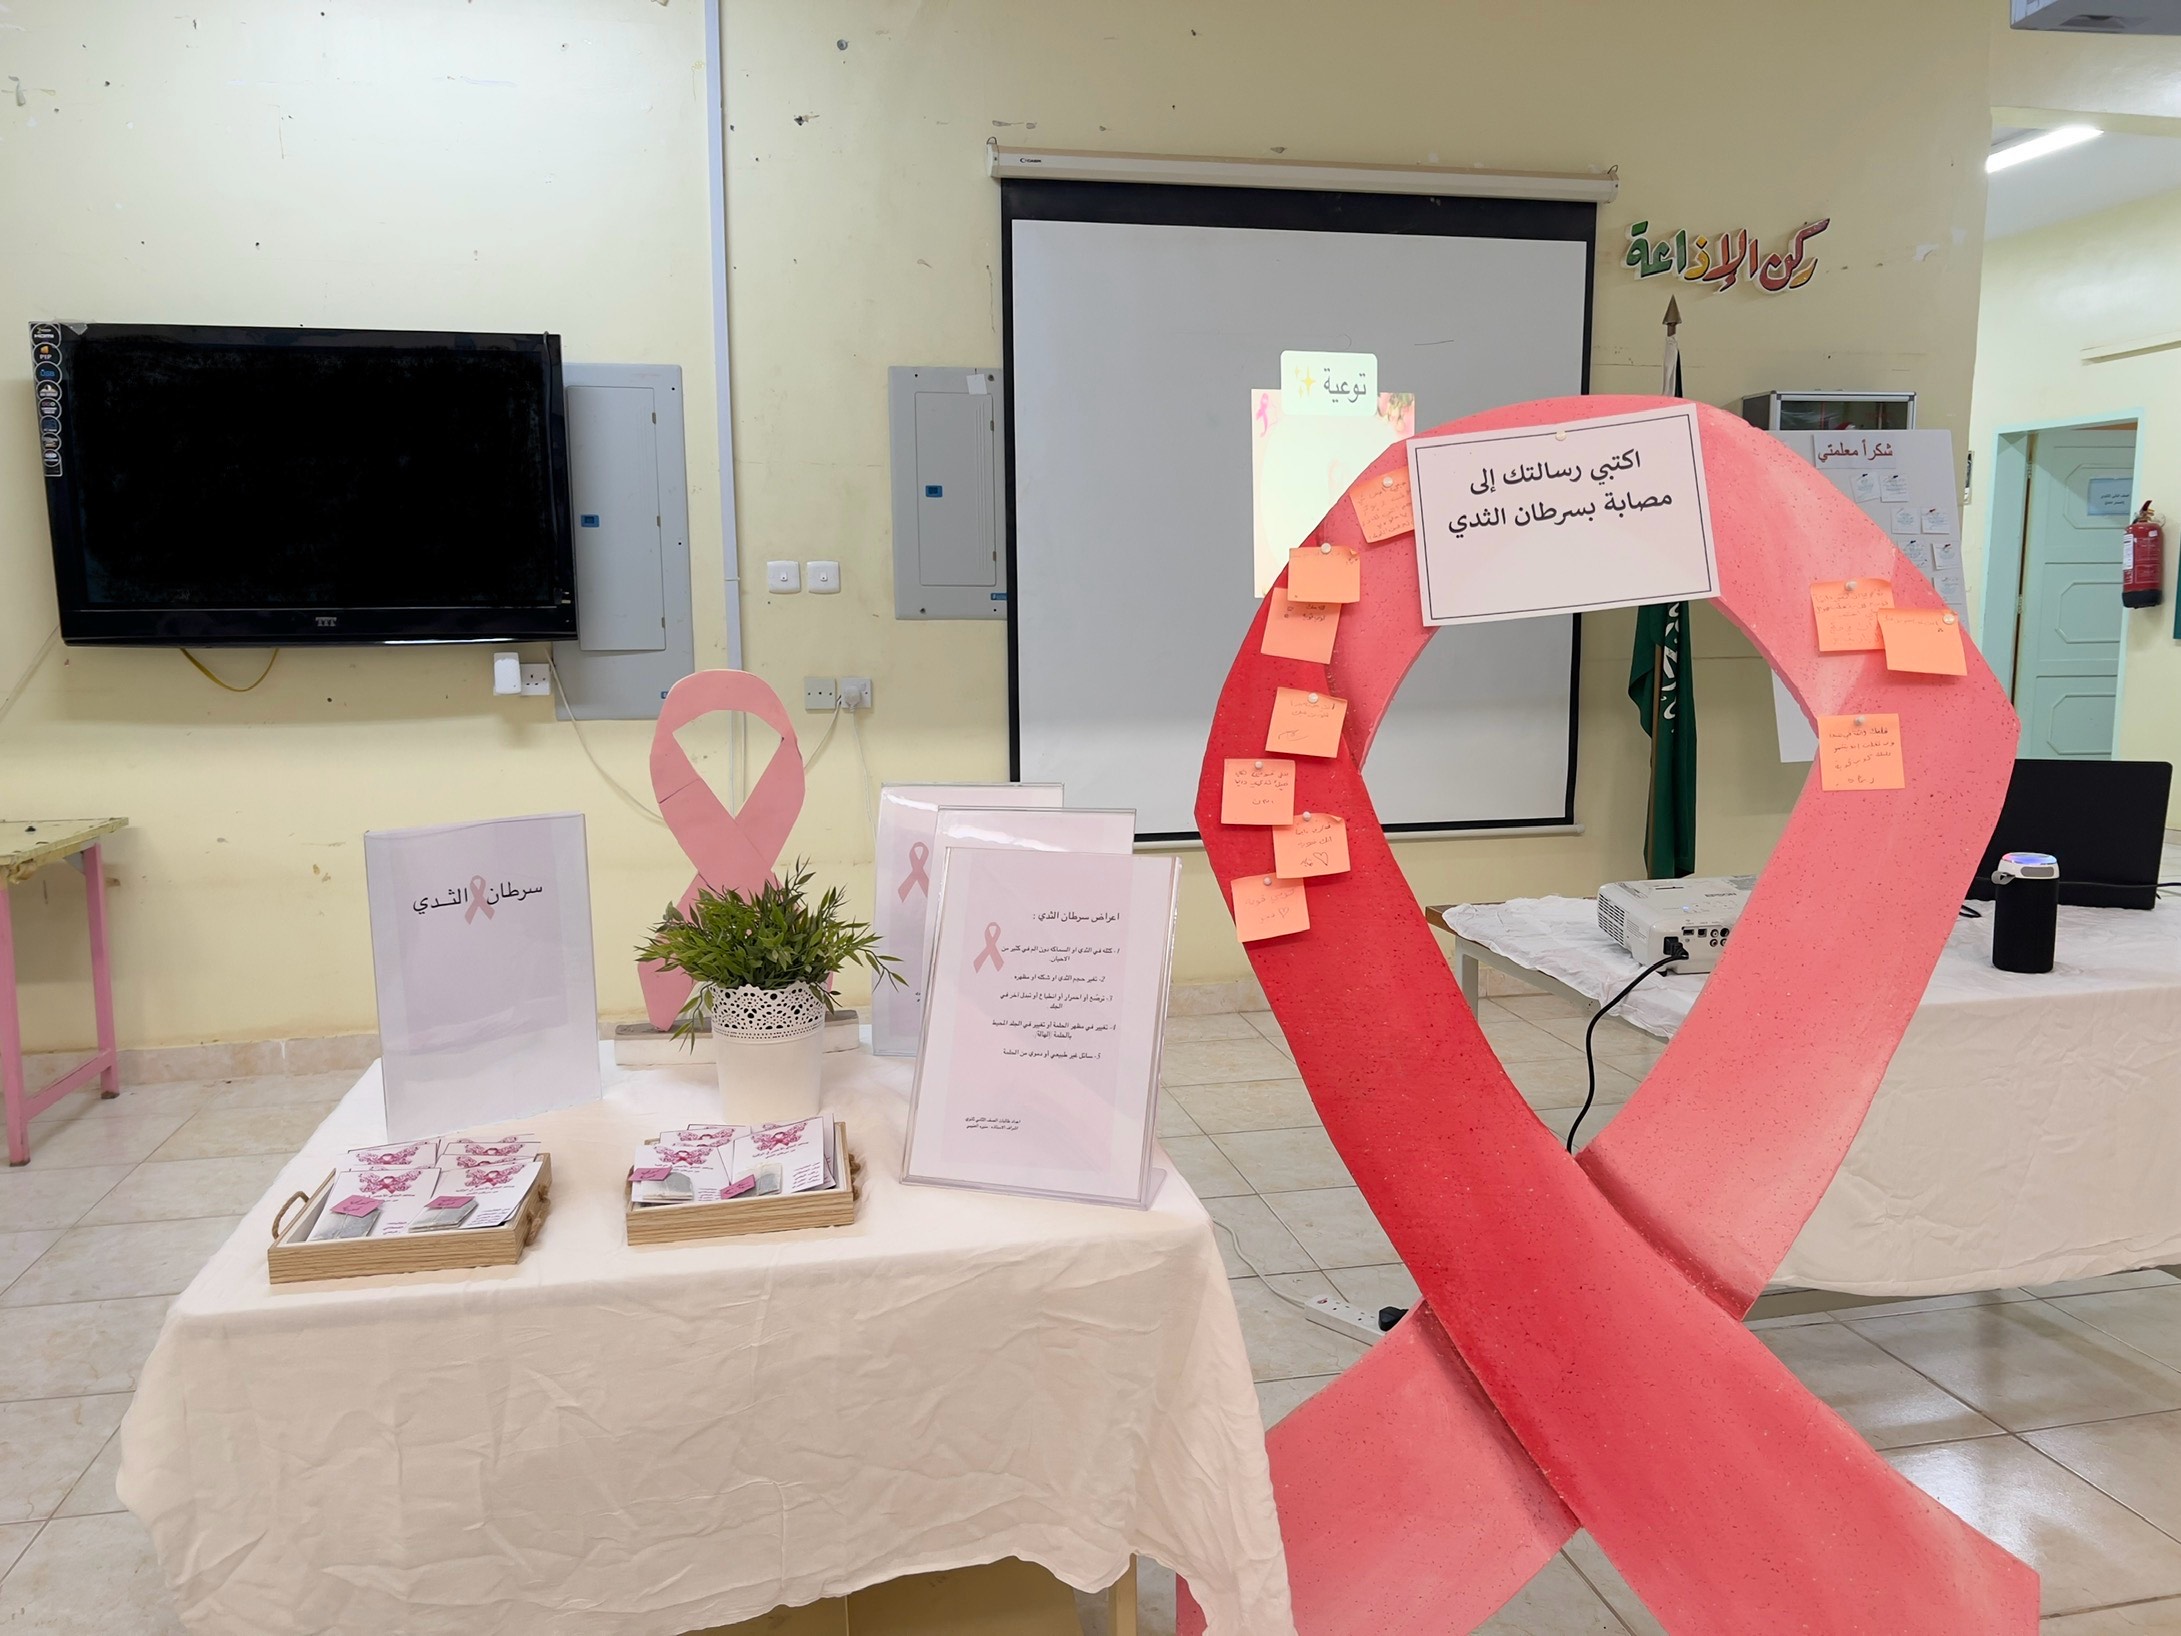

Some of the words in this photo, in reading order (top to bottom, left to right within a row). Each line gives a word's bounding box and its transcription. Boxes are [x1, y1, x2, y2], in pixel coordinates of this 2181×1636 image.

[1626, 220, 1758, 293] الإذاعة
[1758, 218, 1831, 291] ركن
[1323, 368, 1367, 403] توعية
[1818, 441, 1859, 463] معلمتي
[1503, 462, 1582, 486] رسالتك
[1590, 448, 1641, 486] اكتبي
[1470, 468, 1496, 495] إلى
[1514, 500, 1596, 527] بسرطان
[1604, 490, 1673, 514] مصابة
[1448, 507, 1507, 539] الثدي
[412, 887, 469, 915] الثدي
[486, 881, 543, 906] سرطان
[1038, 911, 1059, 922] الثدي
[1061, 911, 1089, 923] سرطان
